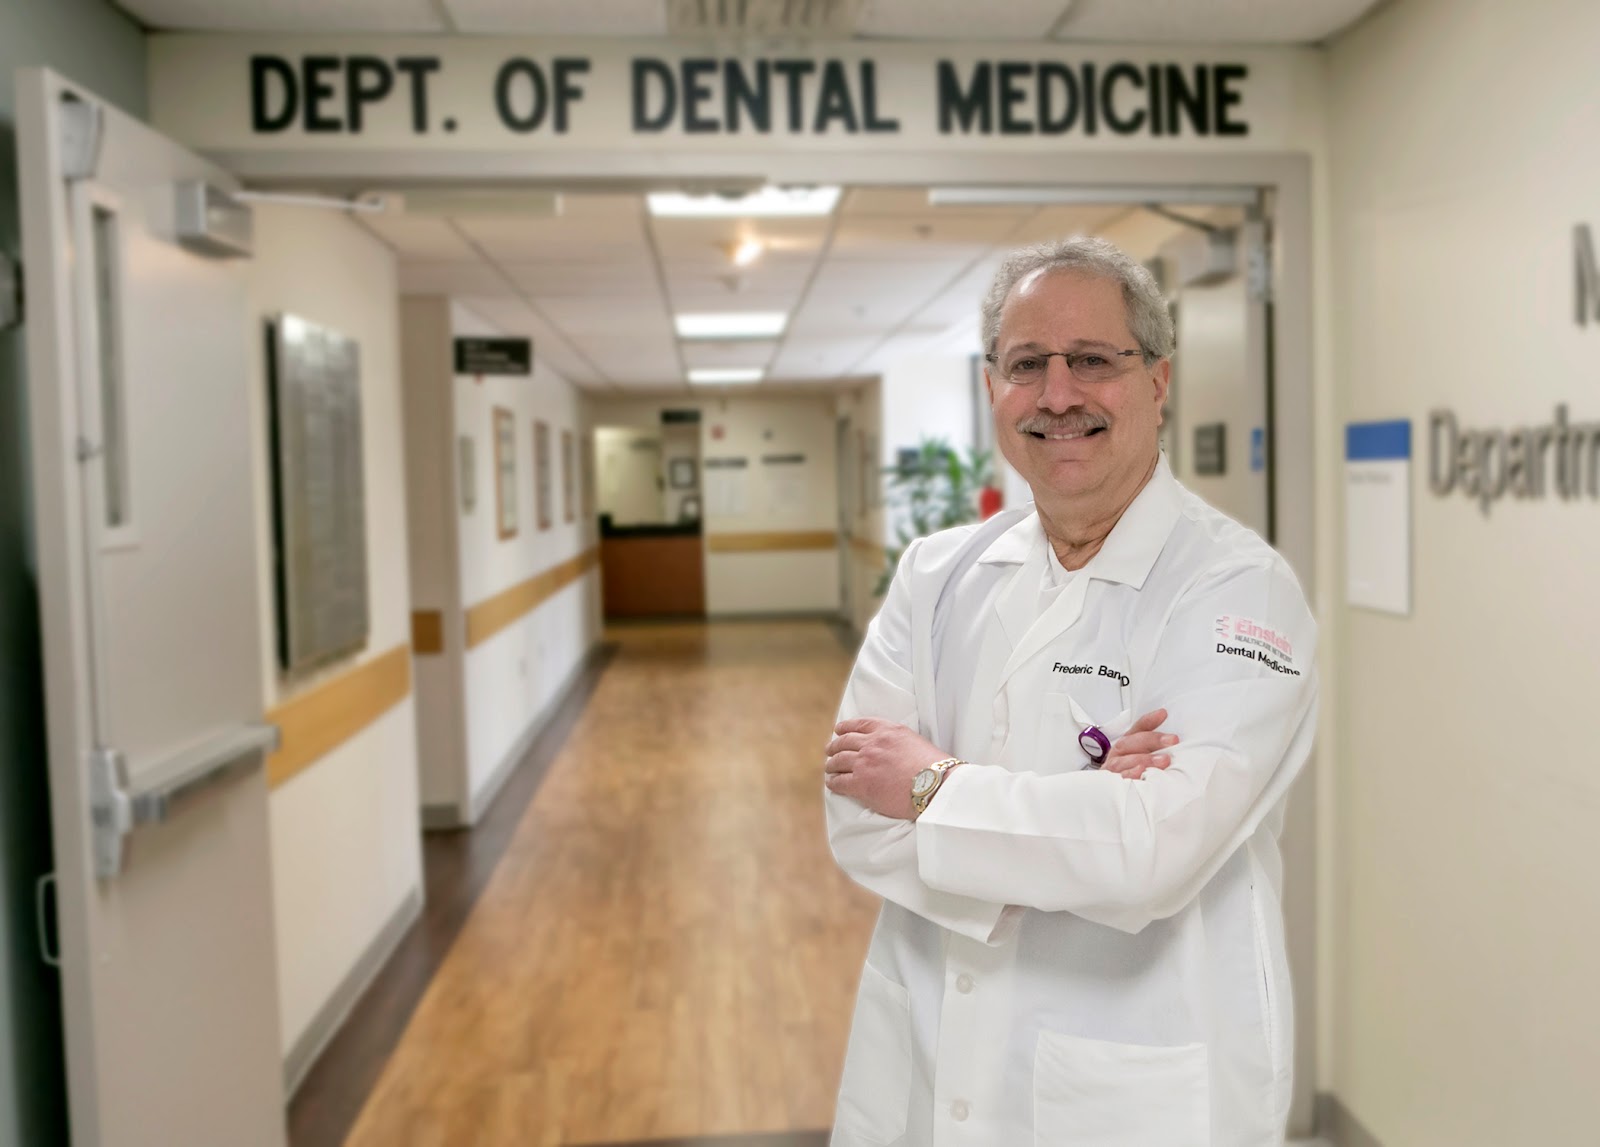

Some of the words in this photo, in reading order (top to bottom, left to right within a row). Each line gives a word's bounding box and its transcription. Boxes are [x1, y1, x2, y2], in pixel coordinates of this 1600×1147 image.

[251, 56, 457, 134] DEPT.
[495, 57, 591, 134] OF
[632, 58, 899, 134] DENTAL
[938, 61, 1248, 136] MEDICINE
[1235, 619, 1293, 655] Einstein
[1052, 662, 1093, 675] Frederic
[1216, 643, 1256, 659] Dental
[1258, 651, 1301, 676] Medicine
